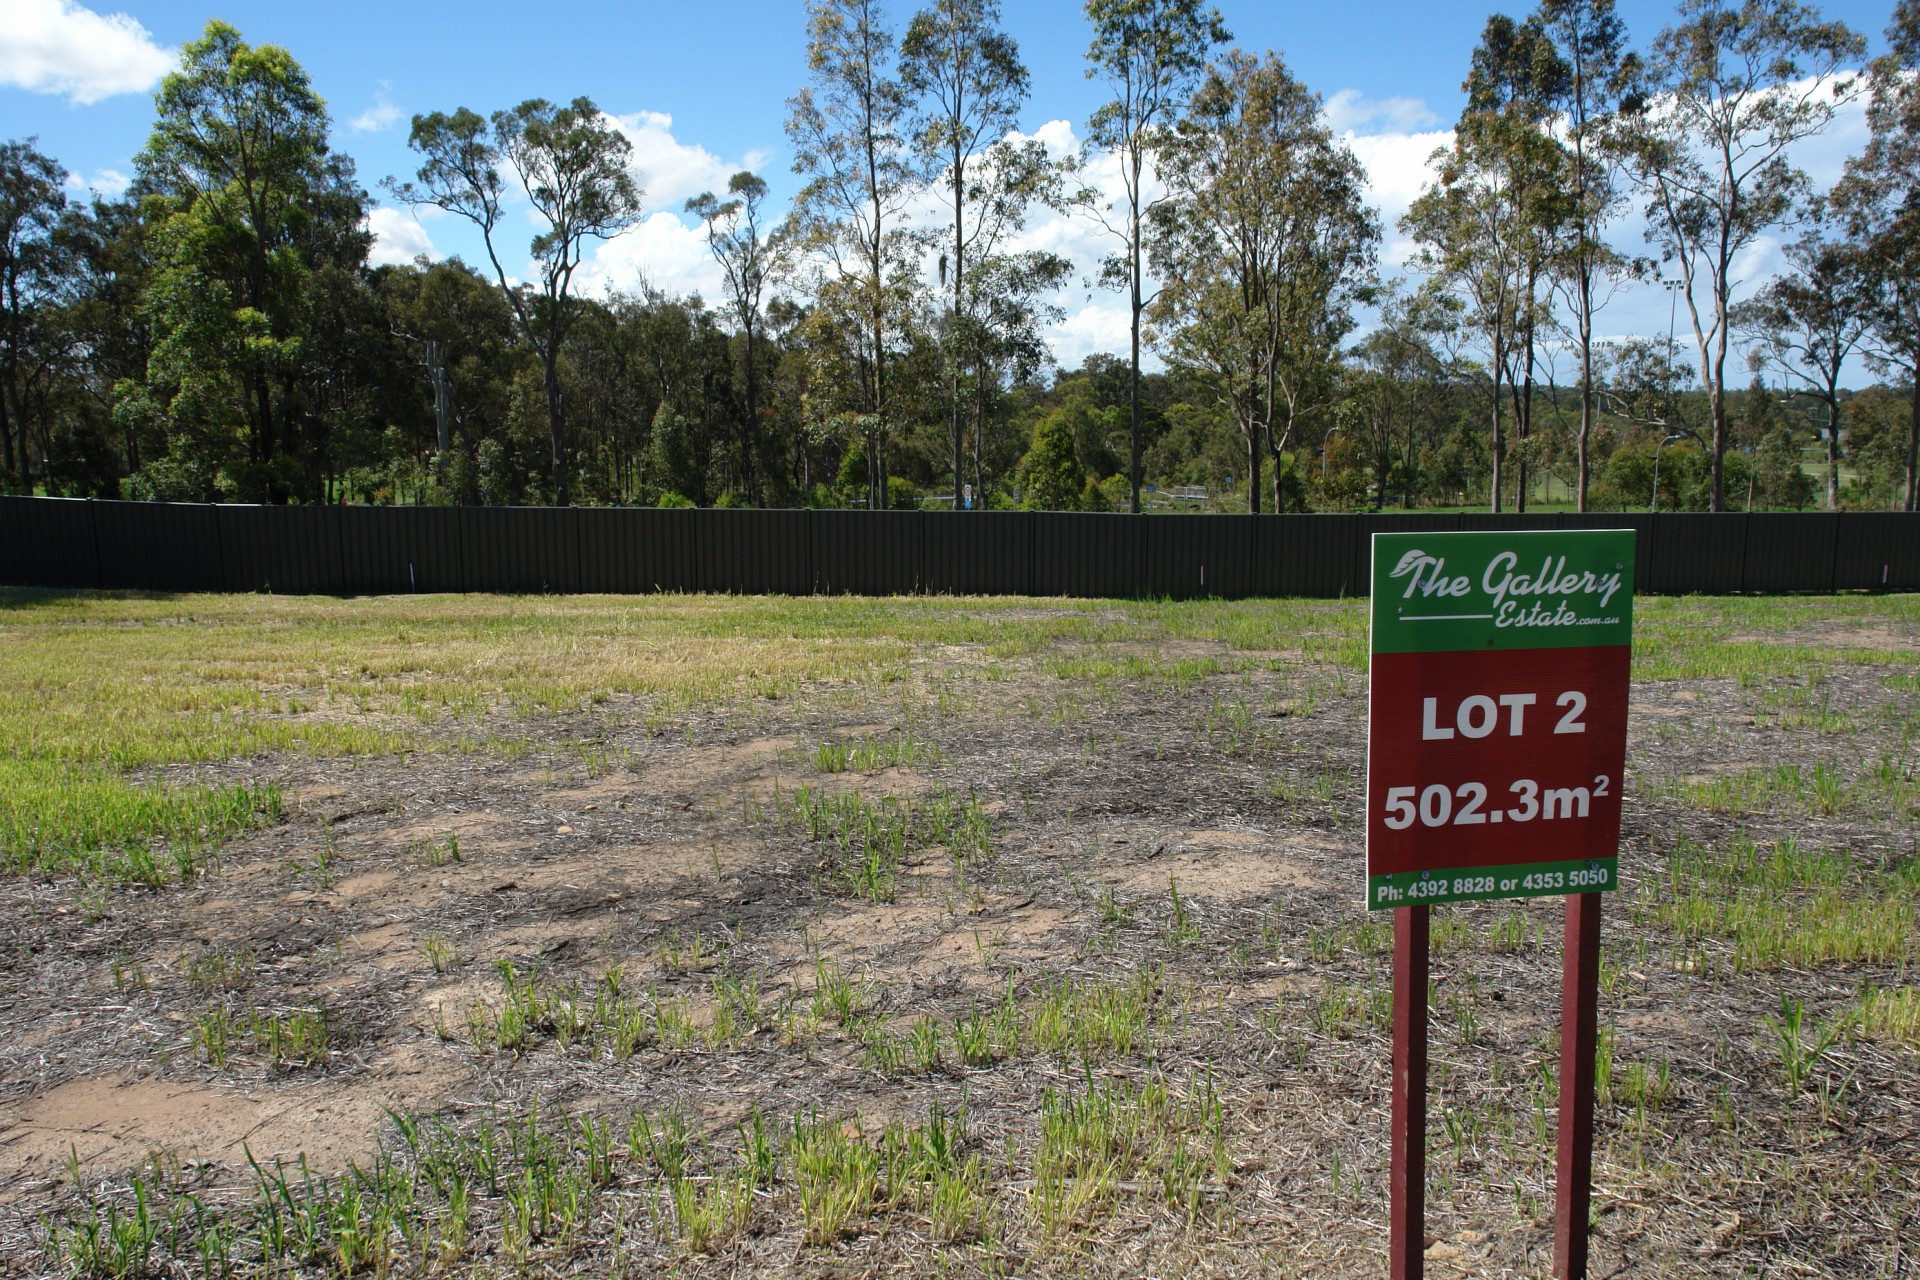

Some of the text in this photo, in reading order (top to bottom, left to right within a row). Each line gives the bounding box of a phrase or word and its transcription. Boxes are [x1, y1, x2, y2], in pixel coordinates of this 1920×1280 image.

[1392, 551, 1621, 608] The Gallery
[1422, 691, 1587, 740] LOT 2
[1377, 868, 1608, 902] Ph: 4392 8828 or 4353 5050
